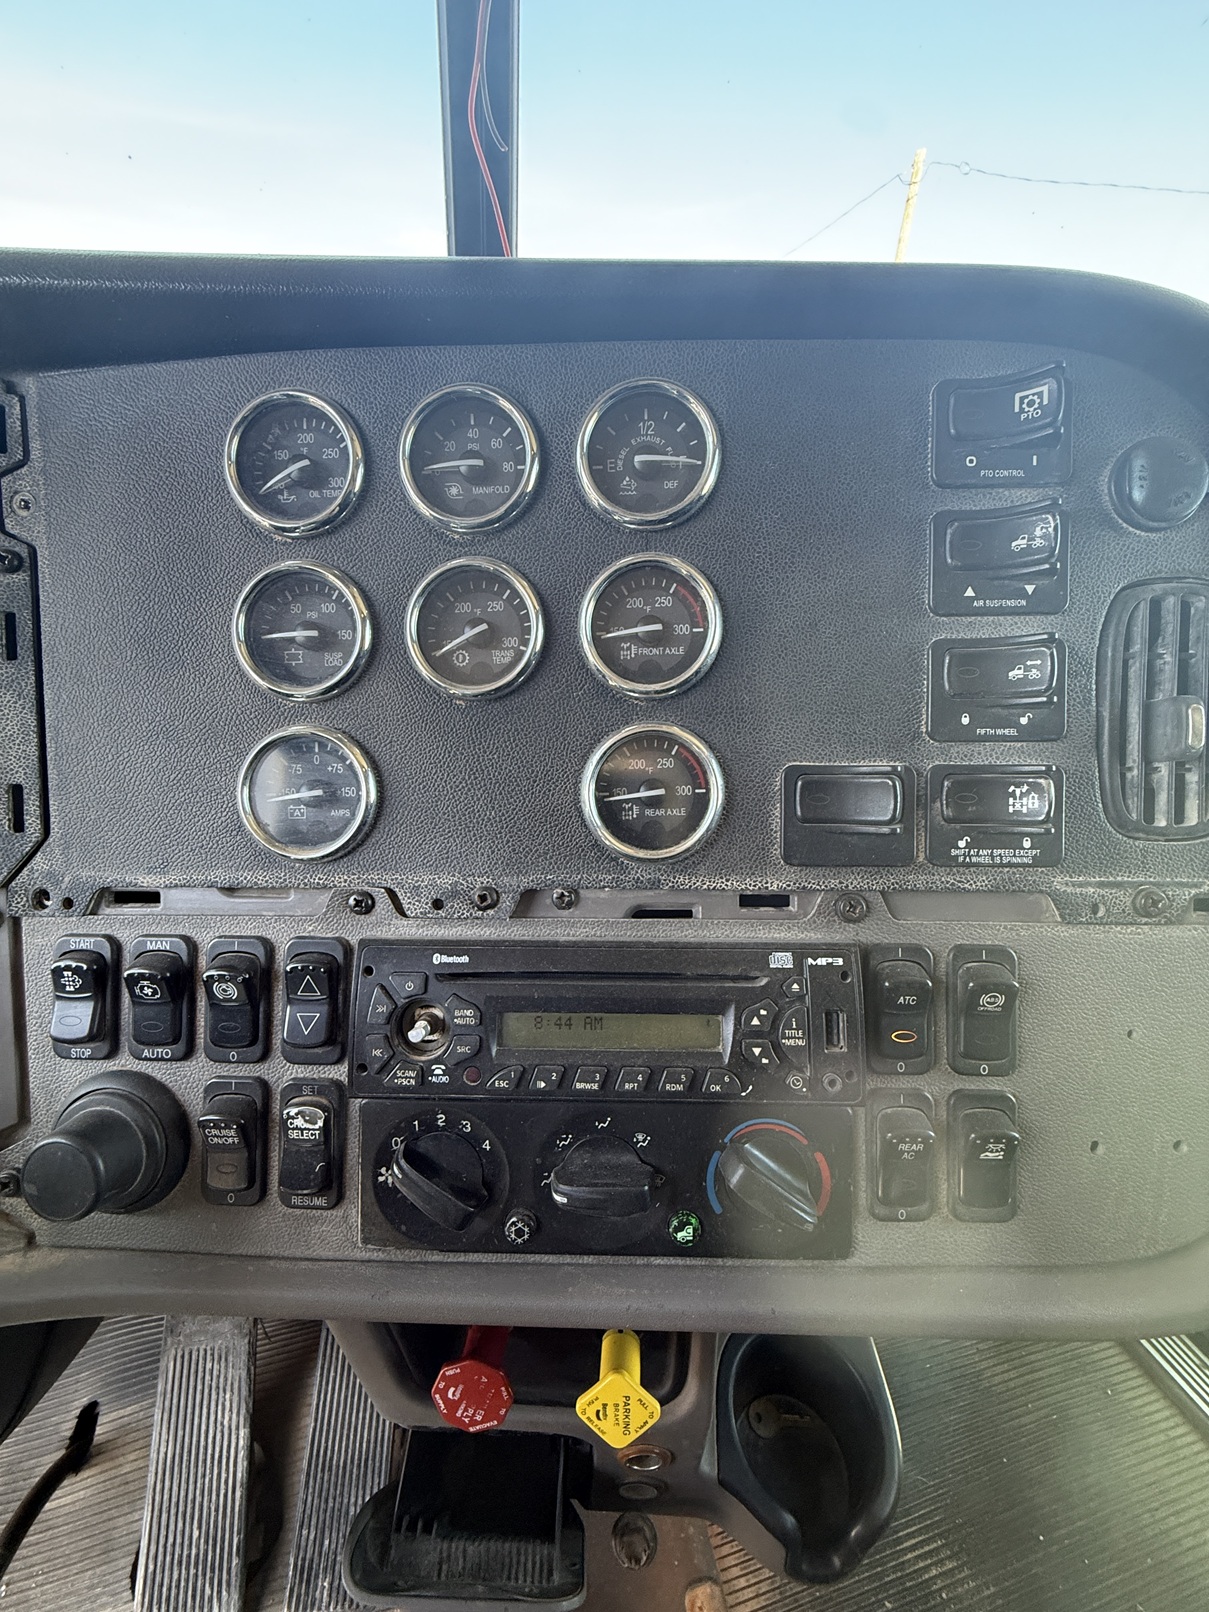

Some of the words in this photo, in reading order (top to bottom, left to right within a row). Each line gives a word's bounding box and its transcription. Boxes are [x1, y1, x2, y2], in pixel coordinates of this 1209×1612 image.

[1021, 409, 1042, 421] PTO
[638, 421, 655, 434] 1/2
[297, 433, 314, 443] 200
[467, 428, 479, 438] 40
[444, 441, 456, 451] 20
[491, 439, 502, 448] 60
[274, 450, 289, 460] 150
[322, 449, 339, 458] 250
[617, 446, 630, 470] DIESEL
[631, 436, 666, 445] EXHAUST
[503, 462, 514, 472] 80
[608, 460, 616, 472] E
[328, 478, 345, 488] 300
[472, 486, 510, 494] MANIFOLD
[487, 601, 504, 612] 250
[626, 598, 643, 608] 200
[655, 597, 672, 607] 250
[290, 604, 301, 613] 50
[321, 603, 336, 613] 100
[455, 602, 471, 613] 200
[673, 624, 690, 634] 300
[338, 630, 352, 639] 150
[502, 637, 518, 647] 300
[314, 755, 320, 764] 0
[628, 759, 645, 769] 200
[657, 758, 674, 768] 250
[288, 764, 302, 774] -75
[327, 764, 343, 773] +75
[612, 788, 627, 796] 150
[675, 786, 692, 796] 300
[70, 940, 95, 949] START
[147, 941, 170, 950] MAN
[440, 954, 469, 963] Bluetooth
[808, 958, 843, 966] MP3
[897, 996, 917, 1005] ATC
[534, 1016, 573, 1030] 8:44
[584, 1017, 604, 1030] AM
[70, 1048, 92, 1058] STOP
[142, 1049, 172, 1058] AUTO
[302, 1086, 318, 1095] SET
[436, 1114, 446, 1126] 2
[413, 1120, 419, 1131] 1
[462, 1120, 471, 1132] 3
[205, 1128, 238, 1137] CRUISE
[288, 1130, 320, 1139] SELECT
[208, 1137, 239, 1145] ON/OFF
[392, 1137, 400, 1149] 0
[482, 1139, 491, 1150] 4
[291, 1196, 328, 1206] RESUME
[637, 1398, 649, 1411] PULL
[648, 1411, 654, 1420] TO
[622, 1396, 631, 1436] PARKING
[468, 1420, 498, 1432] EVACUATE
